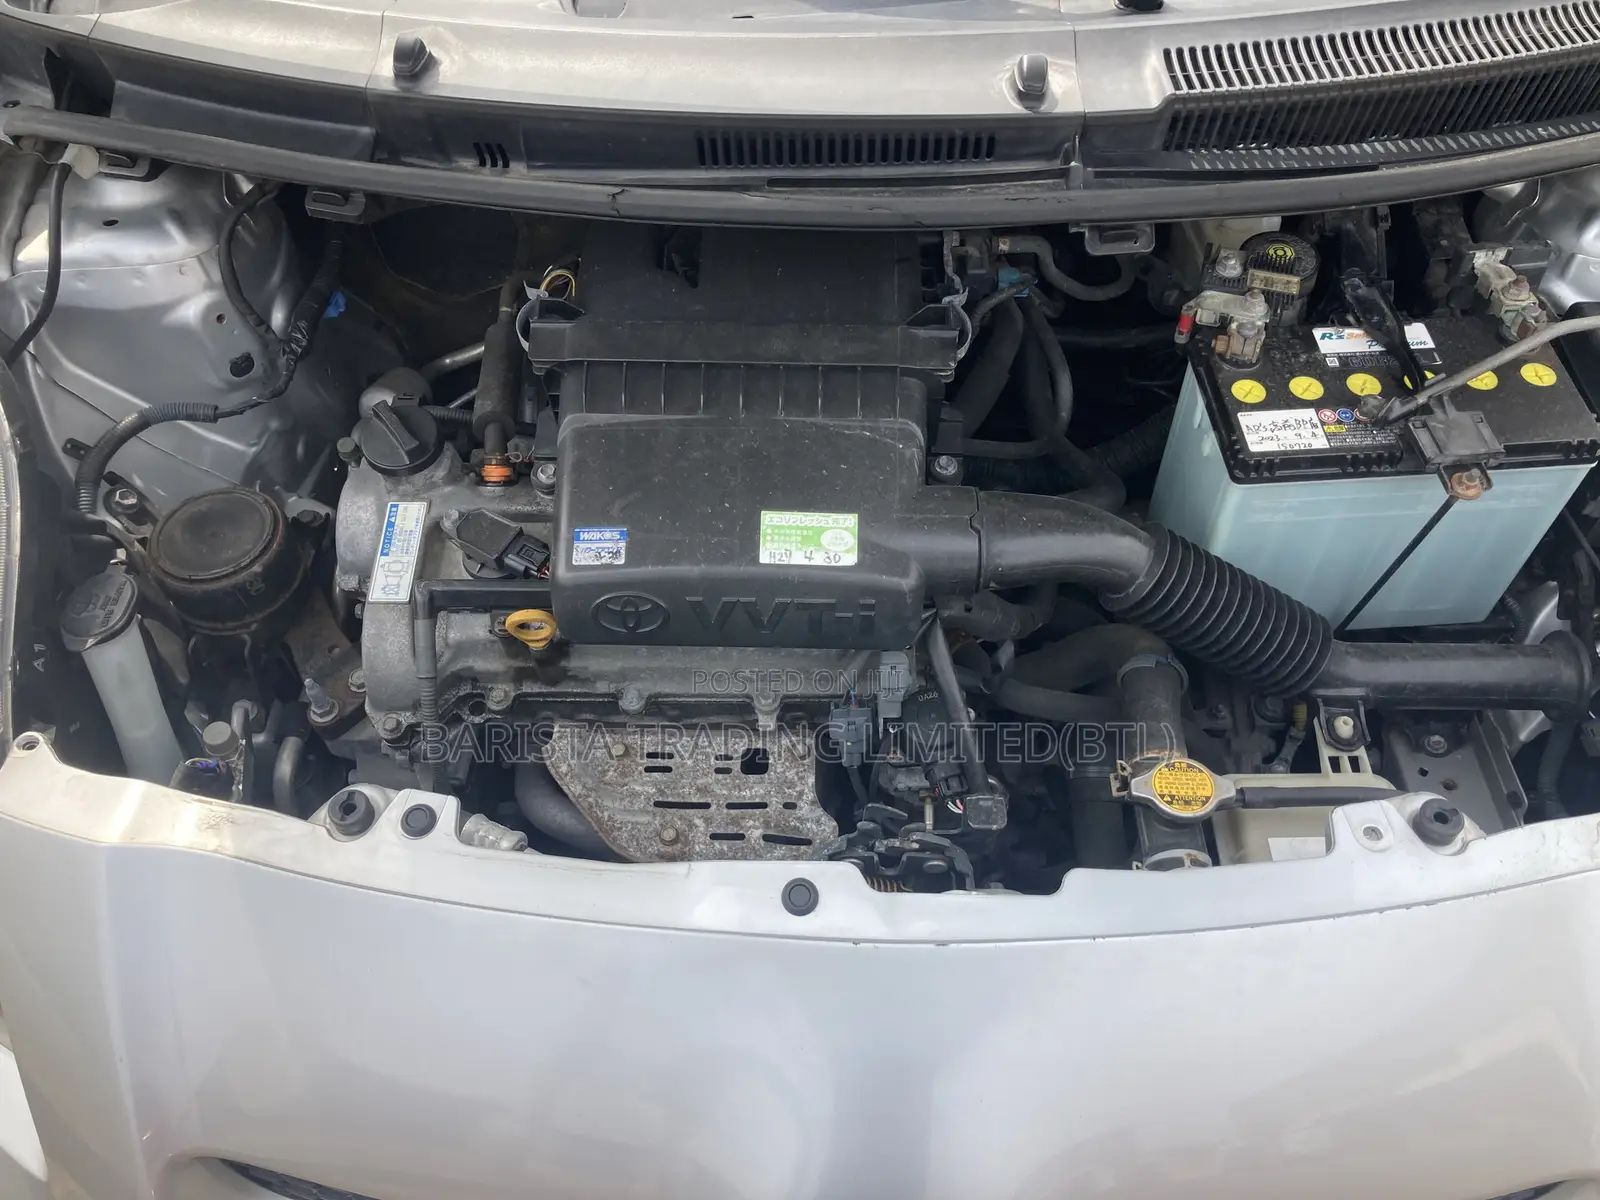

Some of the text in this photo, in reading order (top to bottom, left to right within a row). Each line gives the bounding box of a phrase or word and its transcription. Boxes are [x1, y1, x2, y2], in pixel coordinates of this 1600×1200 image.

[382, 527, 394, 554] NOTICE
[803, 549, 815, 562] 4
[685, 596, 877, 636] VVT-i
